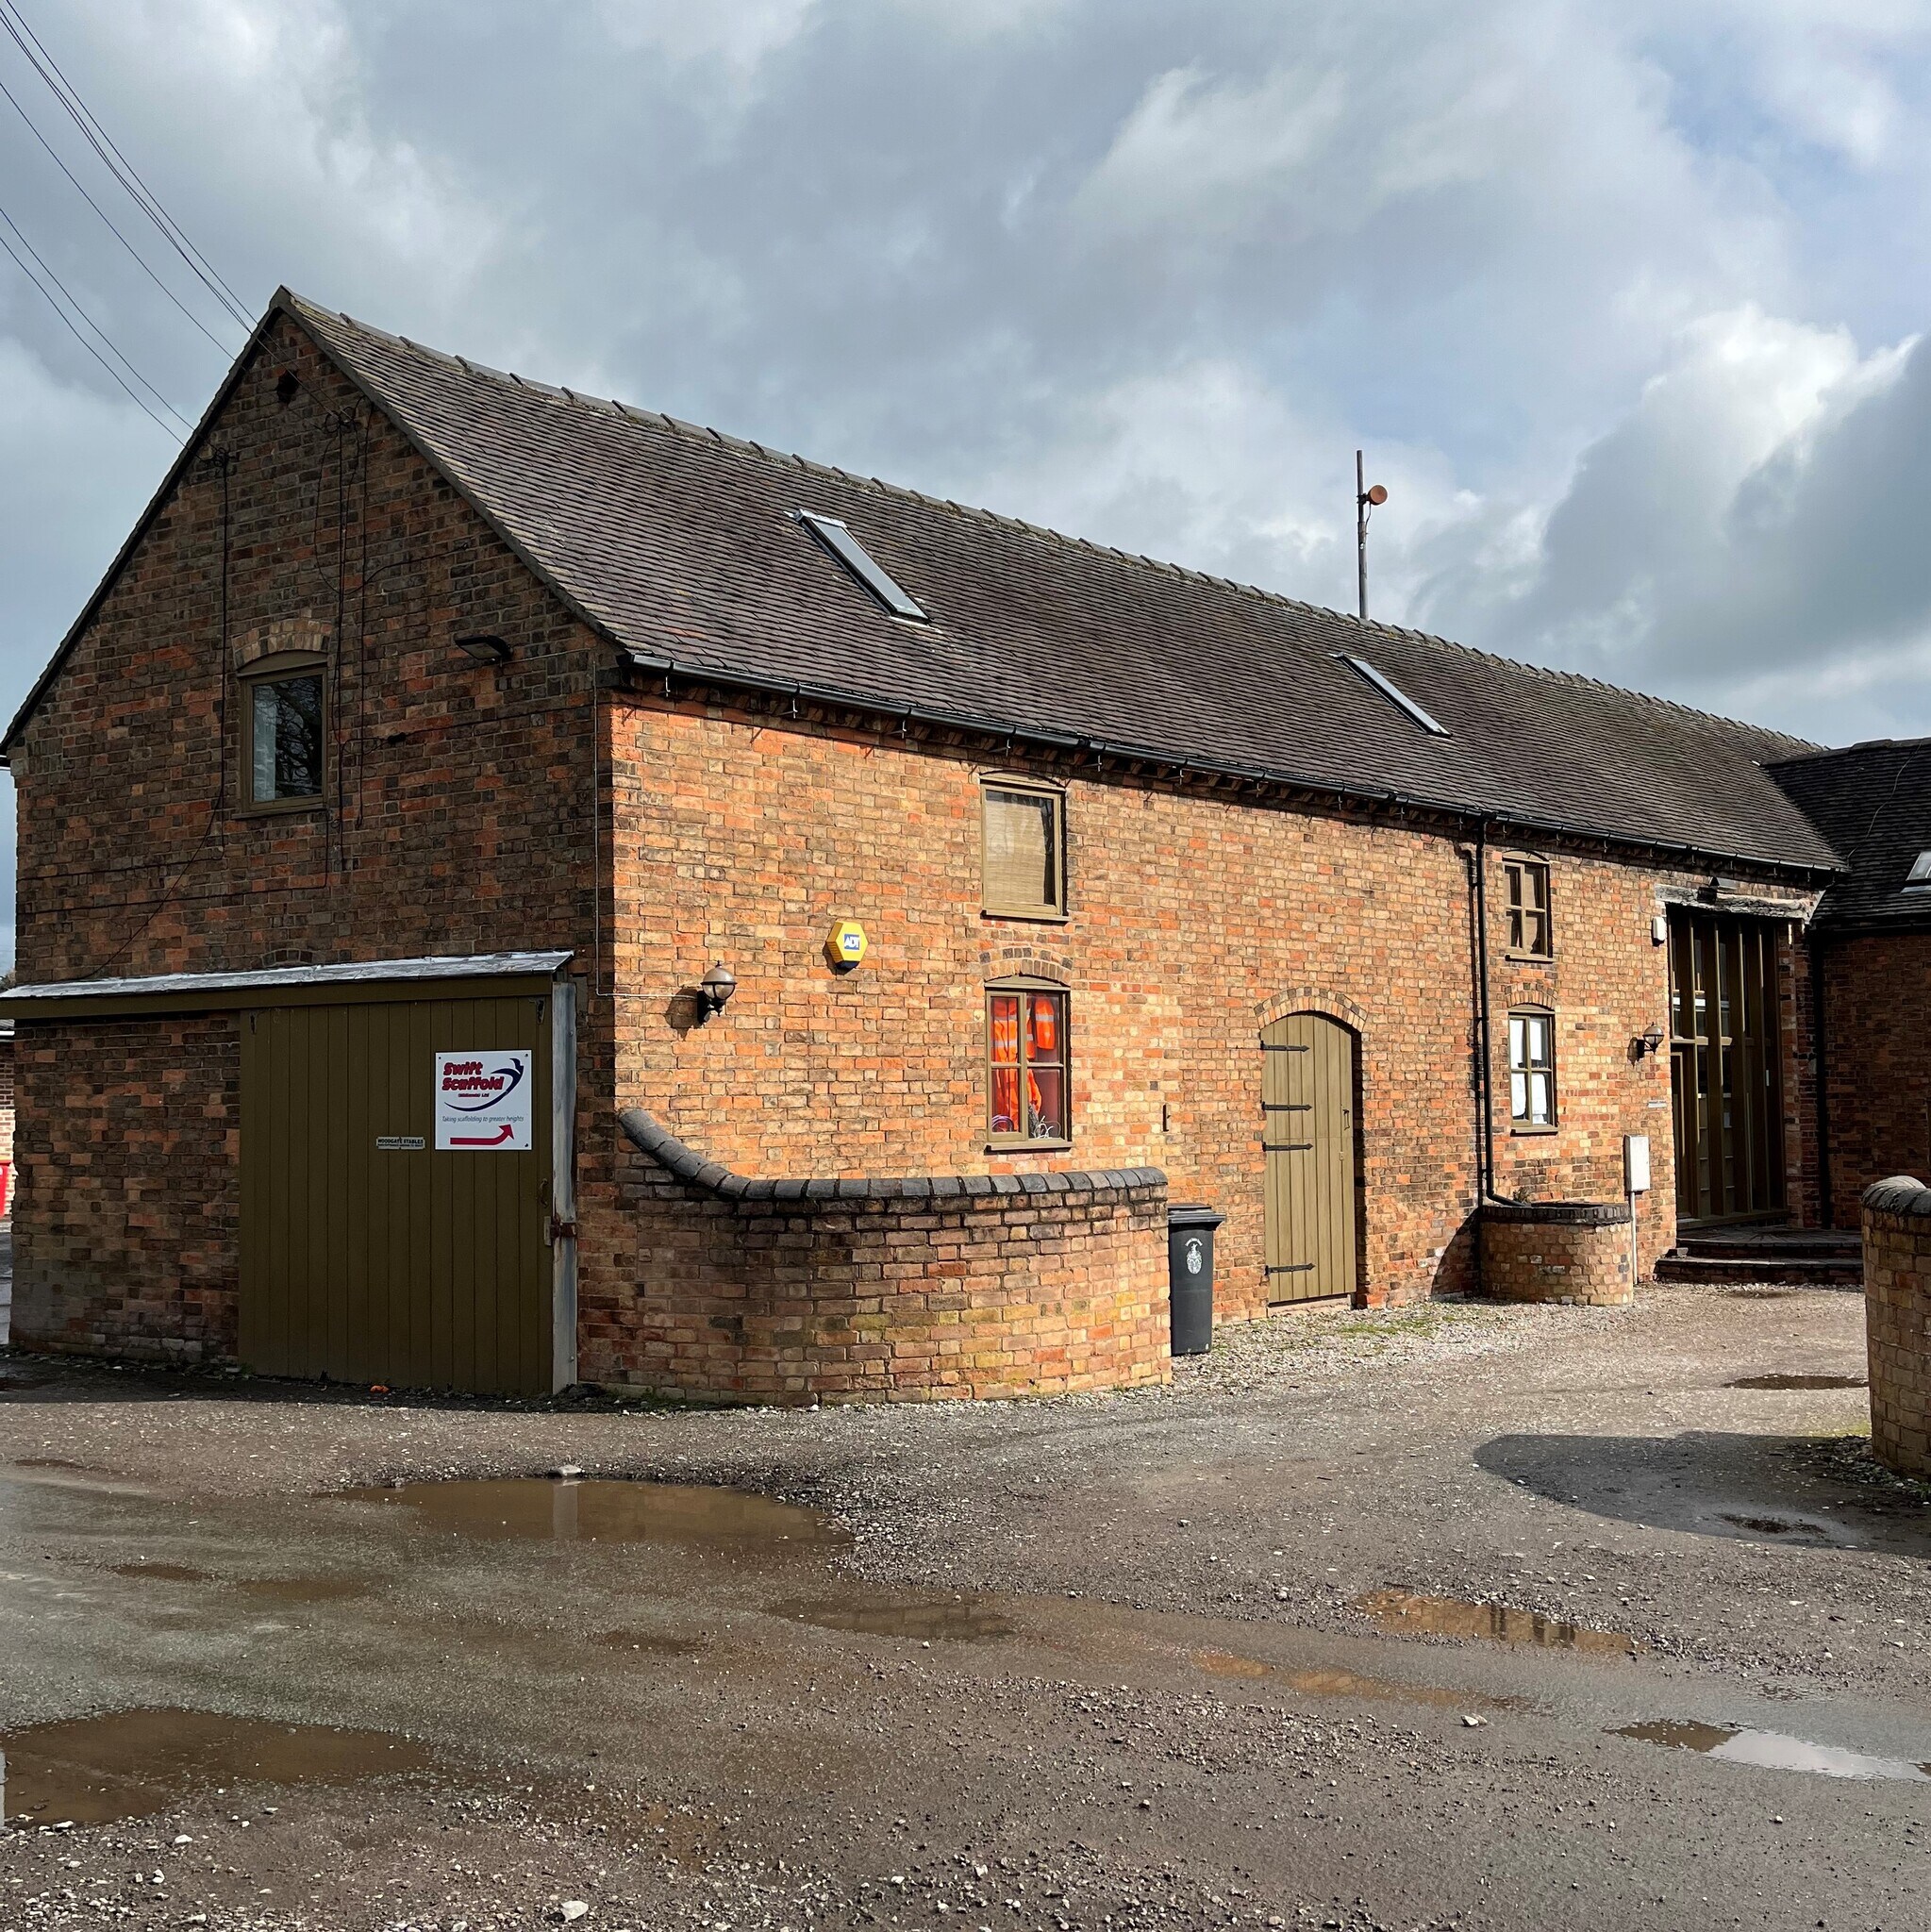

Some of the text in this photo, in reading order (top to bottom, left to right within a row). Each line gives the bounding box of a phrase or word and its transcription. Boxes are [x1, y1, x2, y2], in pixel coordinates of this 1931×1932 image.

[844, 936, 859, 948] ADT
[443, 1061, 483, 1075] Swift
[441, 1076, 504, 1091] Scaffold
[458, 1115, 483, 1124] scaffolding
[507, 1115, 524, 1124] heights
